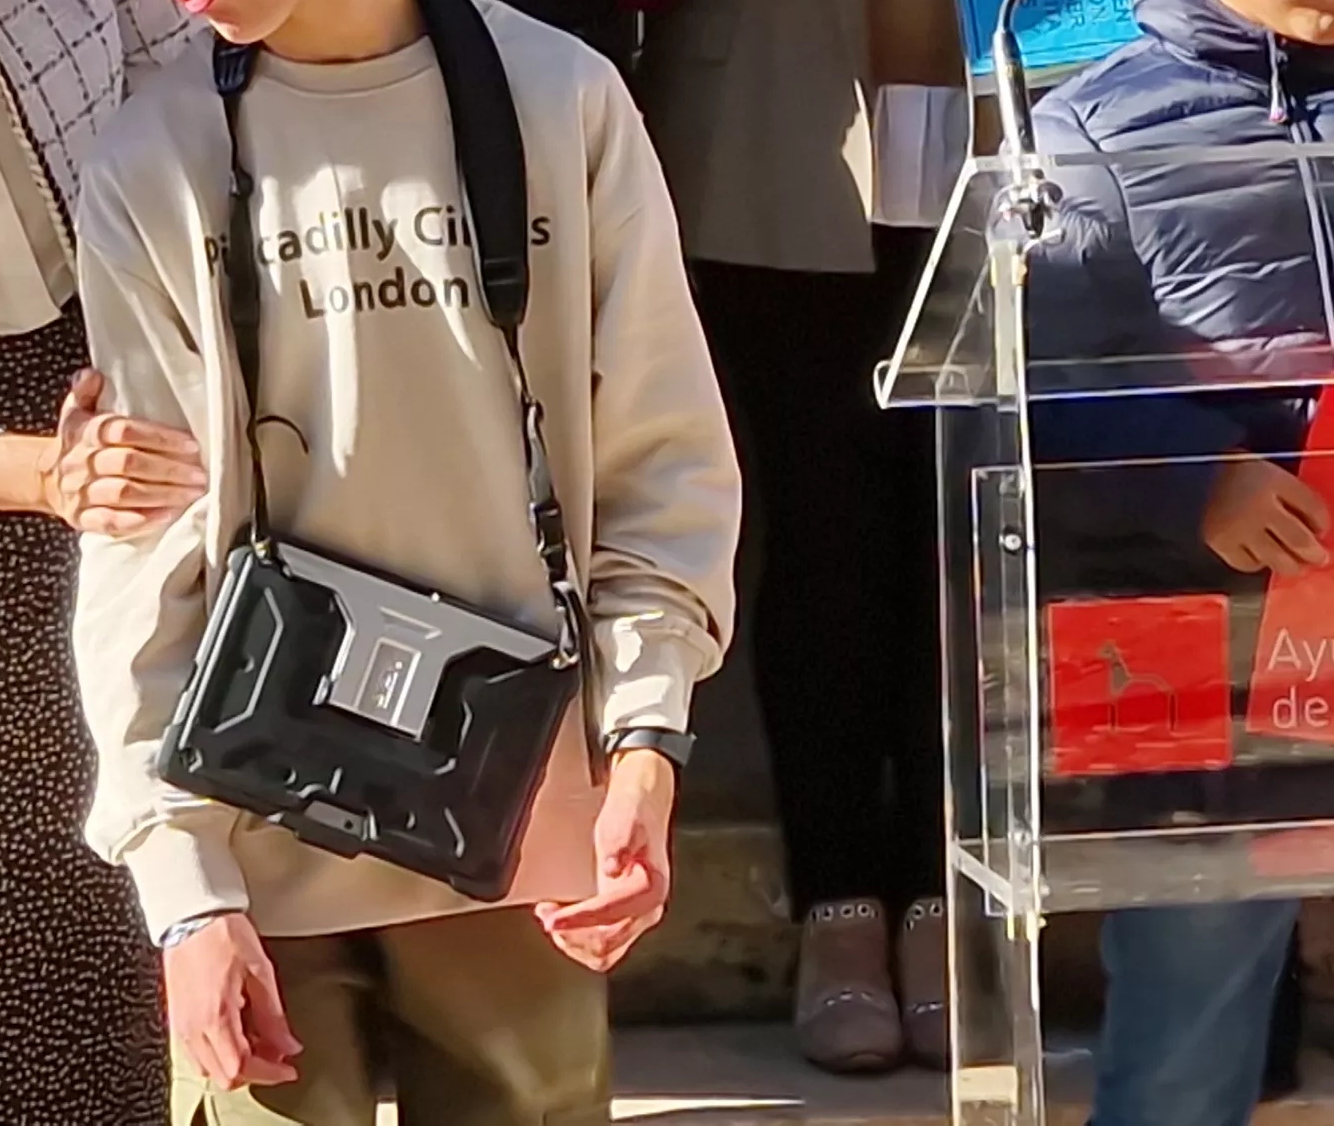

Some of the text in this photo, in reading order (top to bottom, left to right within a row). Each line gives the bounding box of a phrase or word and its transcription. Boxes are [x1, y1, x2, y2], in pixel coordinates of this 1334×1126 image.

[204, 205, 551, 278] Picadilly Cis
[299, 267, 470, 319] London
[1271, 685, 1330, 729] de
